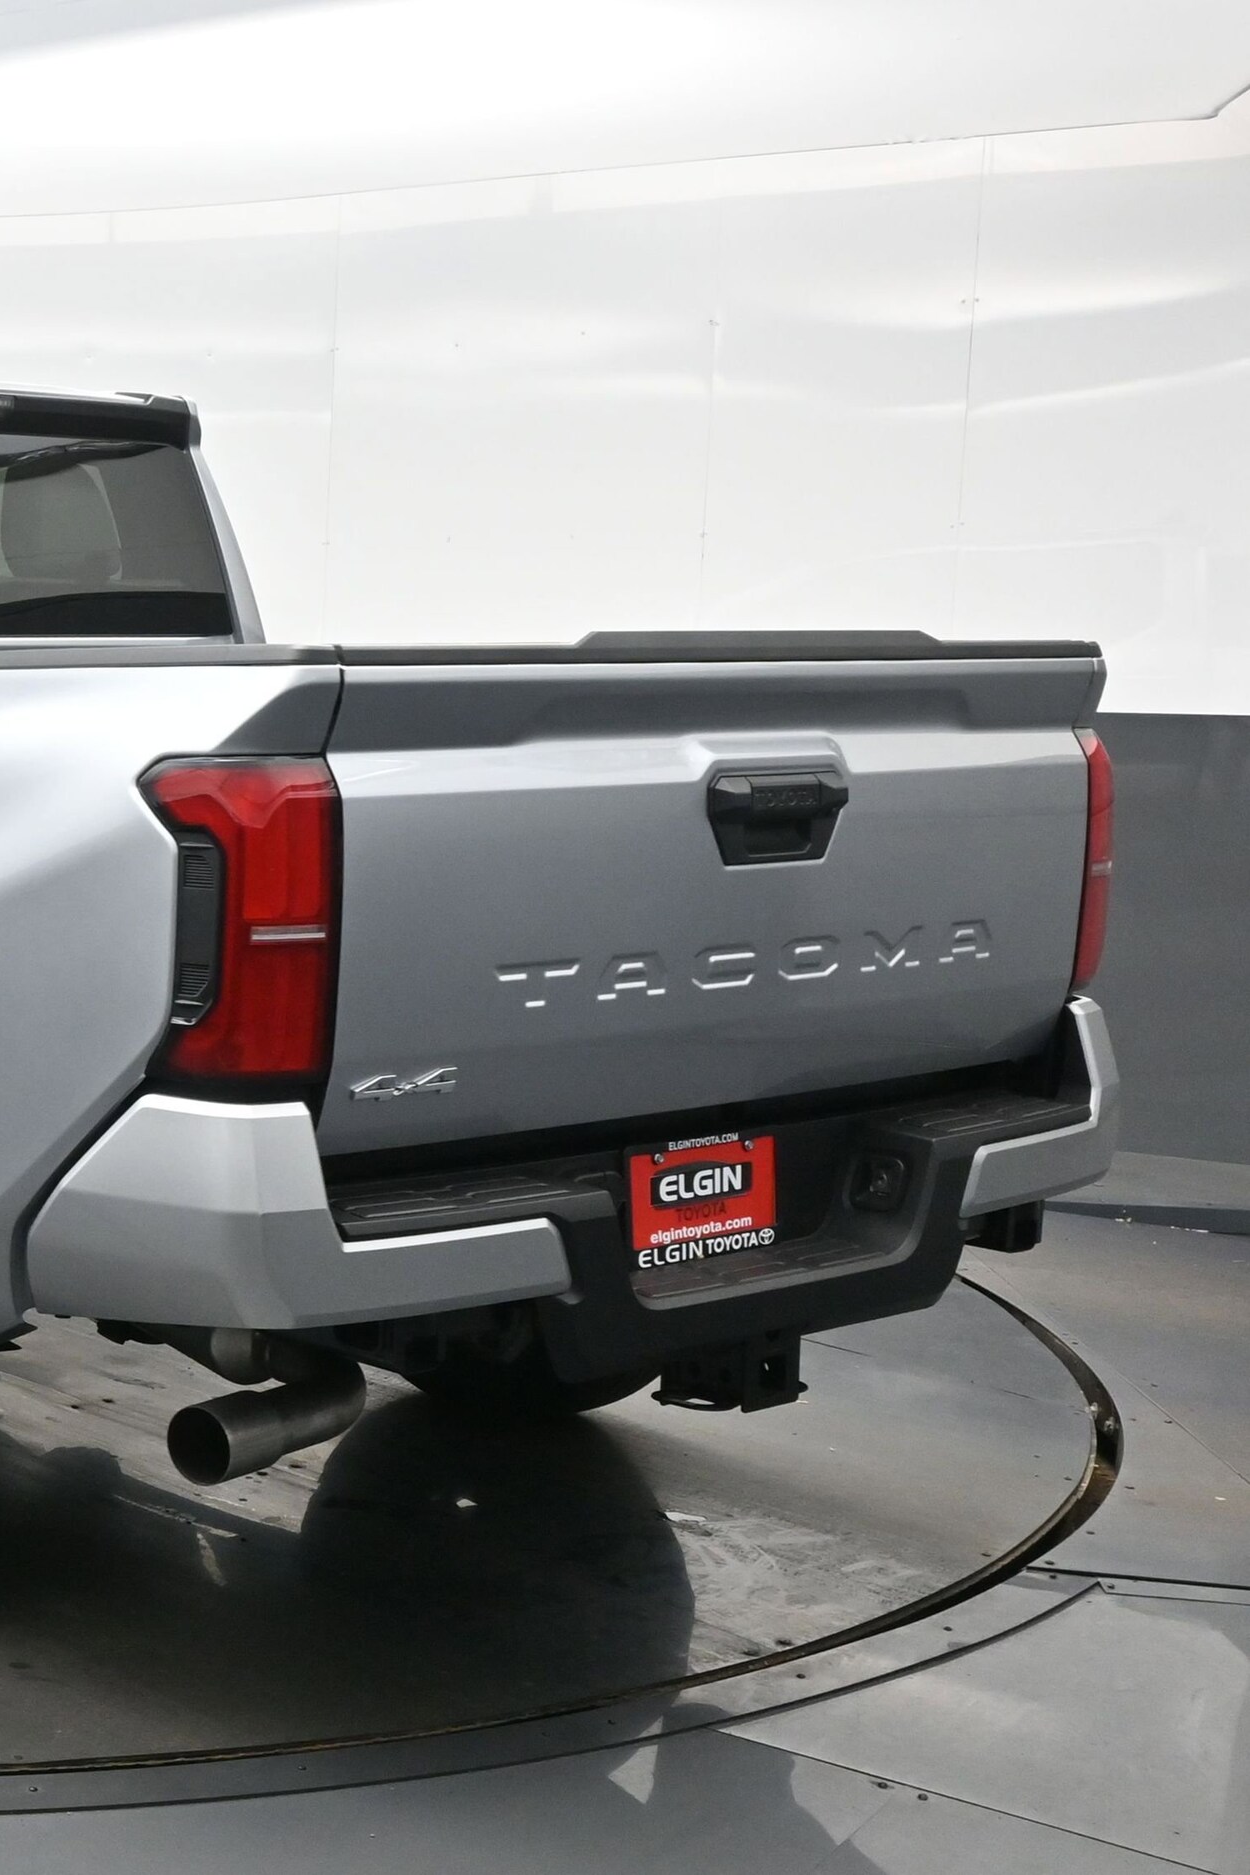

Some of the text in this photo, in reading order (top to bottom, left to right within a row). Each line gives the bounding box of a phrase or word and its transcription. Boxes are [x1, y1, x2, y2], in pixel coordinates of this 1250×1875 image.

[495, 919, 992, 1008] TACOMA
[668, 1132, 739, 1151] ELGINTOYOTA.COM
[659, 1165, 742, 1202] ELGIN
[676, 1202, 727, 1221] TOYOTA
[650, 1216, 752, 1245] elgintoyota.com
[638, 1233, 759, 1268] ELGIN TOYOTA
